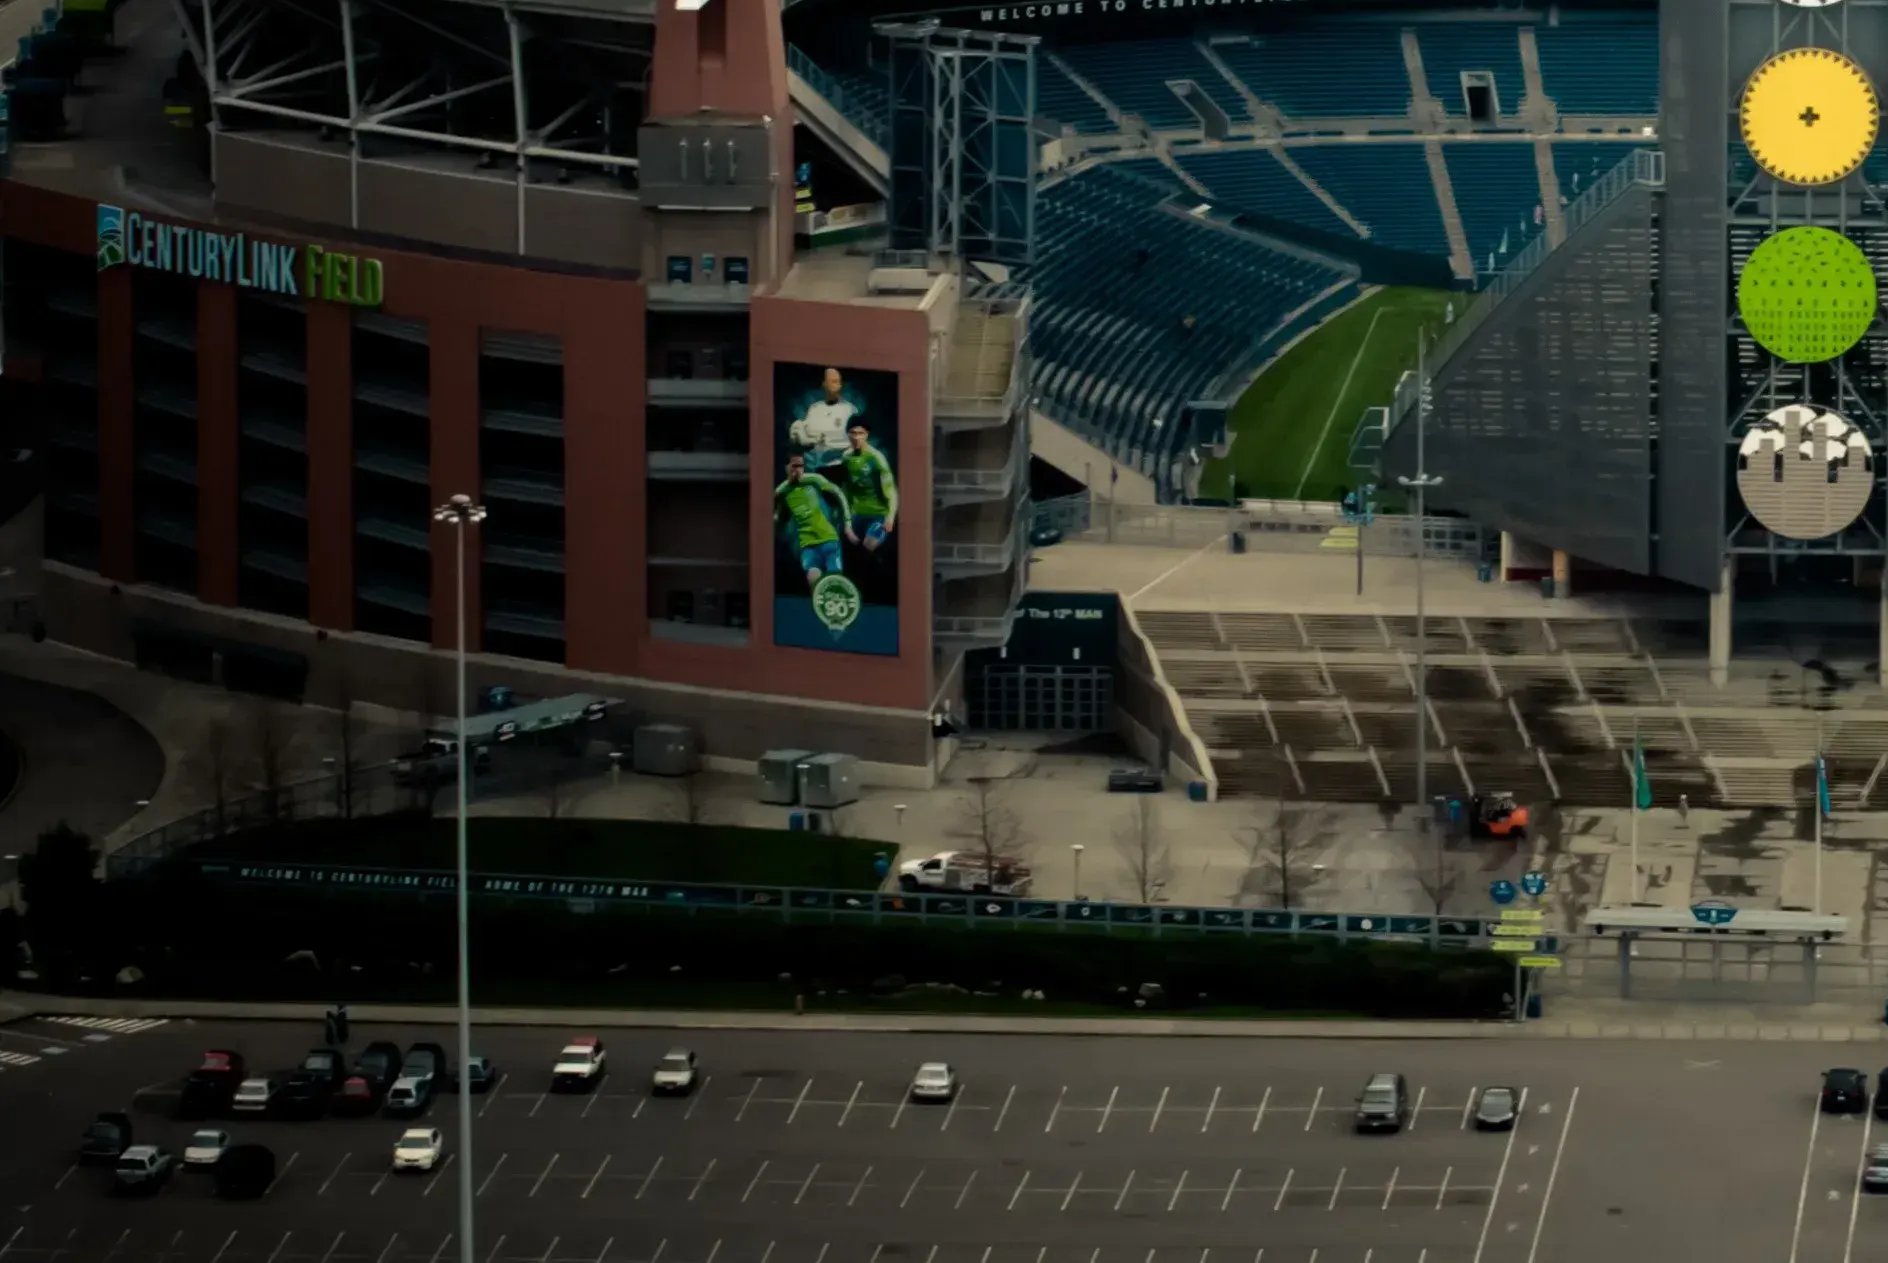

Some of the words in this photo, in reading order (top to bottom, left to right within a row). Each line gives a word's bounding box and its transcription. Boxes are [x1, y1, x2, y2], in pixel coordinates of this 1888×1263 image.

[980, 1, 1084, 22] WELCOME
[1100, 0, 1127, 12] TO
[305, 245, 384, 306] FIELD
